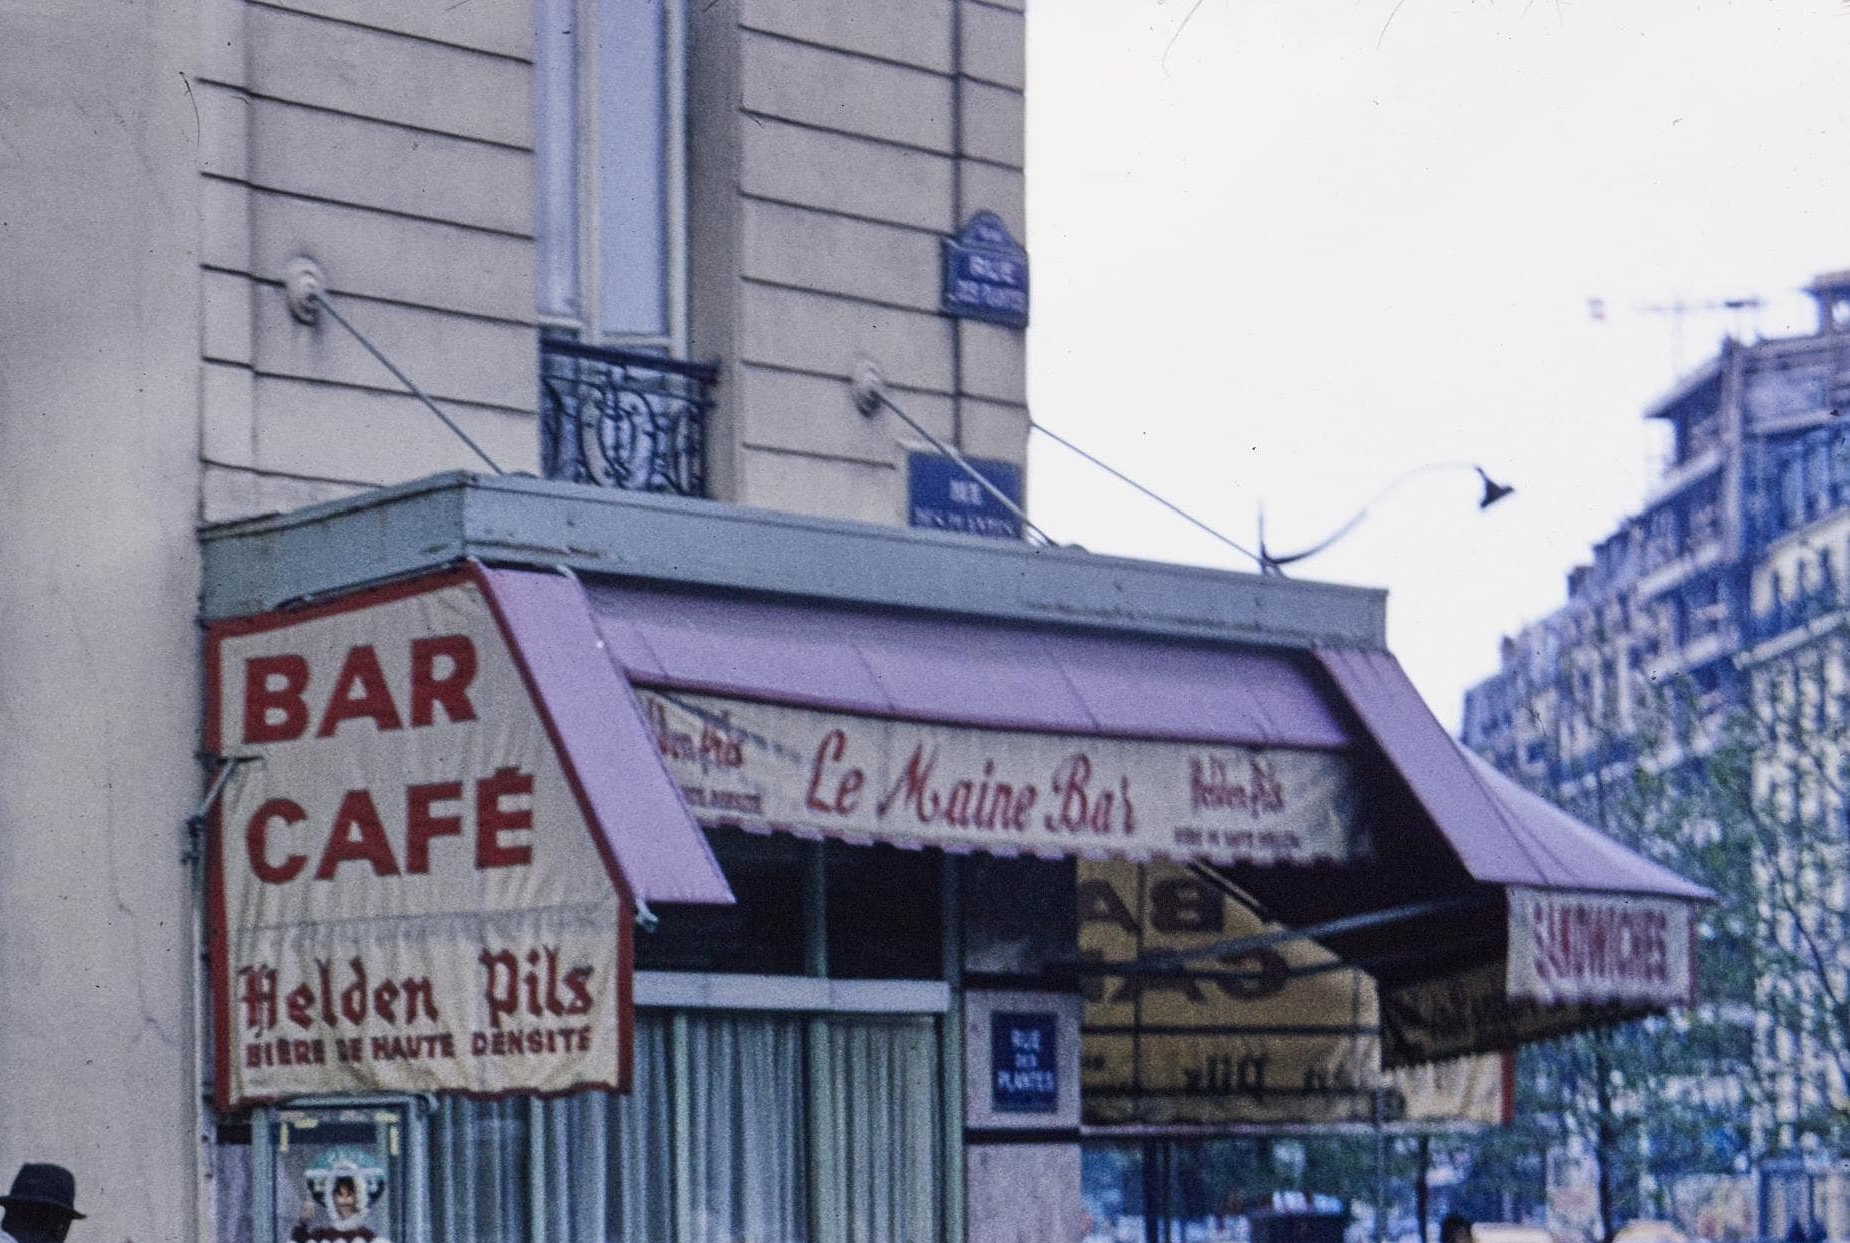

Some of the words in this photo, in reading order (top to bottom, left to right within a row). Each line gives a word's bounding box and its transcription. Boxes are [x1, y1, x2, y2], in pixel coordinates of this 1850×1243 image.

[243, 633, 477, 745] BAR
[246, 766, 536, 885] CAFÉ
[807, 728, 864, 817] Le
[877, 742, 1037, 832] Maine
[237, 955, 439, 1038] Helden
[477, 943, 595, 1029] Pils
[336, 1037, 363, 1063] DE
[371, 1032, 454, 1061] HAUTE
